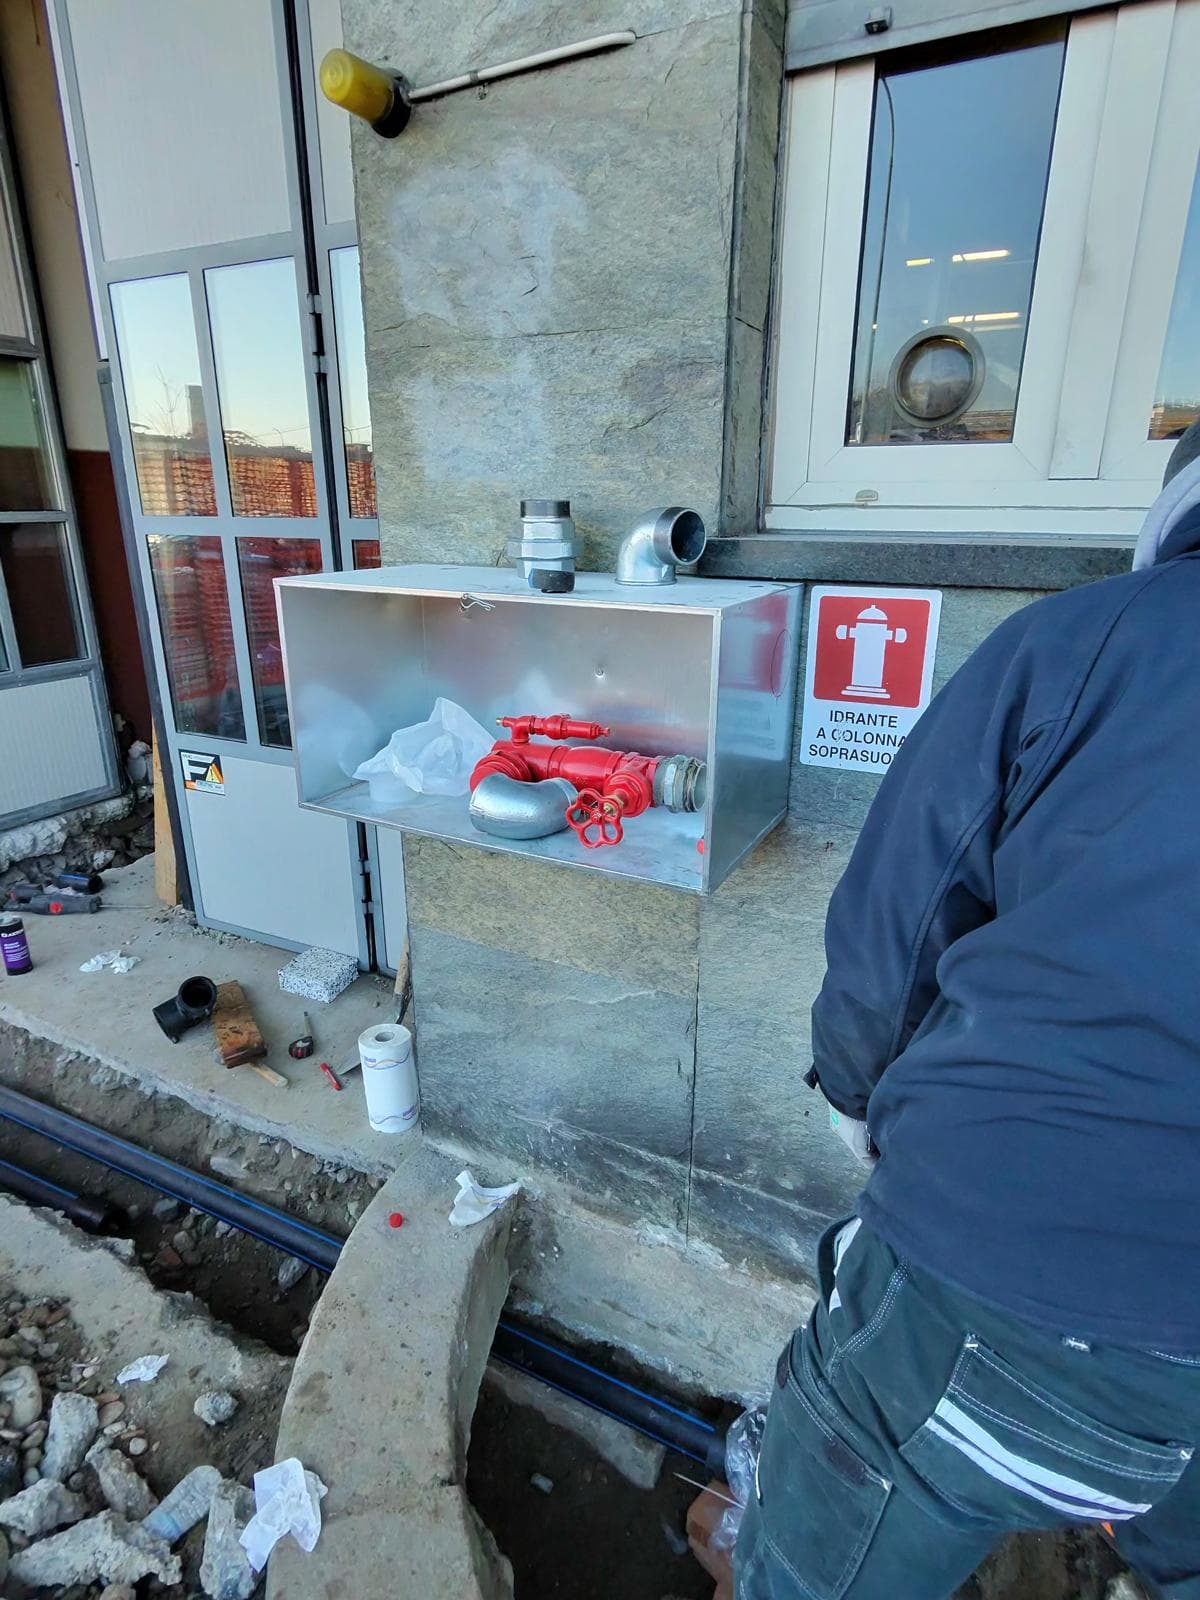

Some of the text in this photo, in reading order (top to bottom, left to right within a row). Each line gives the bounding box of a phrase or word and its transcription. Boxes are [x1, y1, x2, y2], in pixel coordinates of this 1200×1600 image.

[829, 710, 898, 728] IDRANTE
[816, 727, 826, 739] A
[808, 744, 897, 765] SOPRASUO
